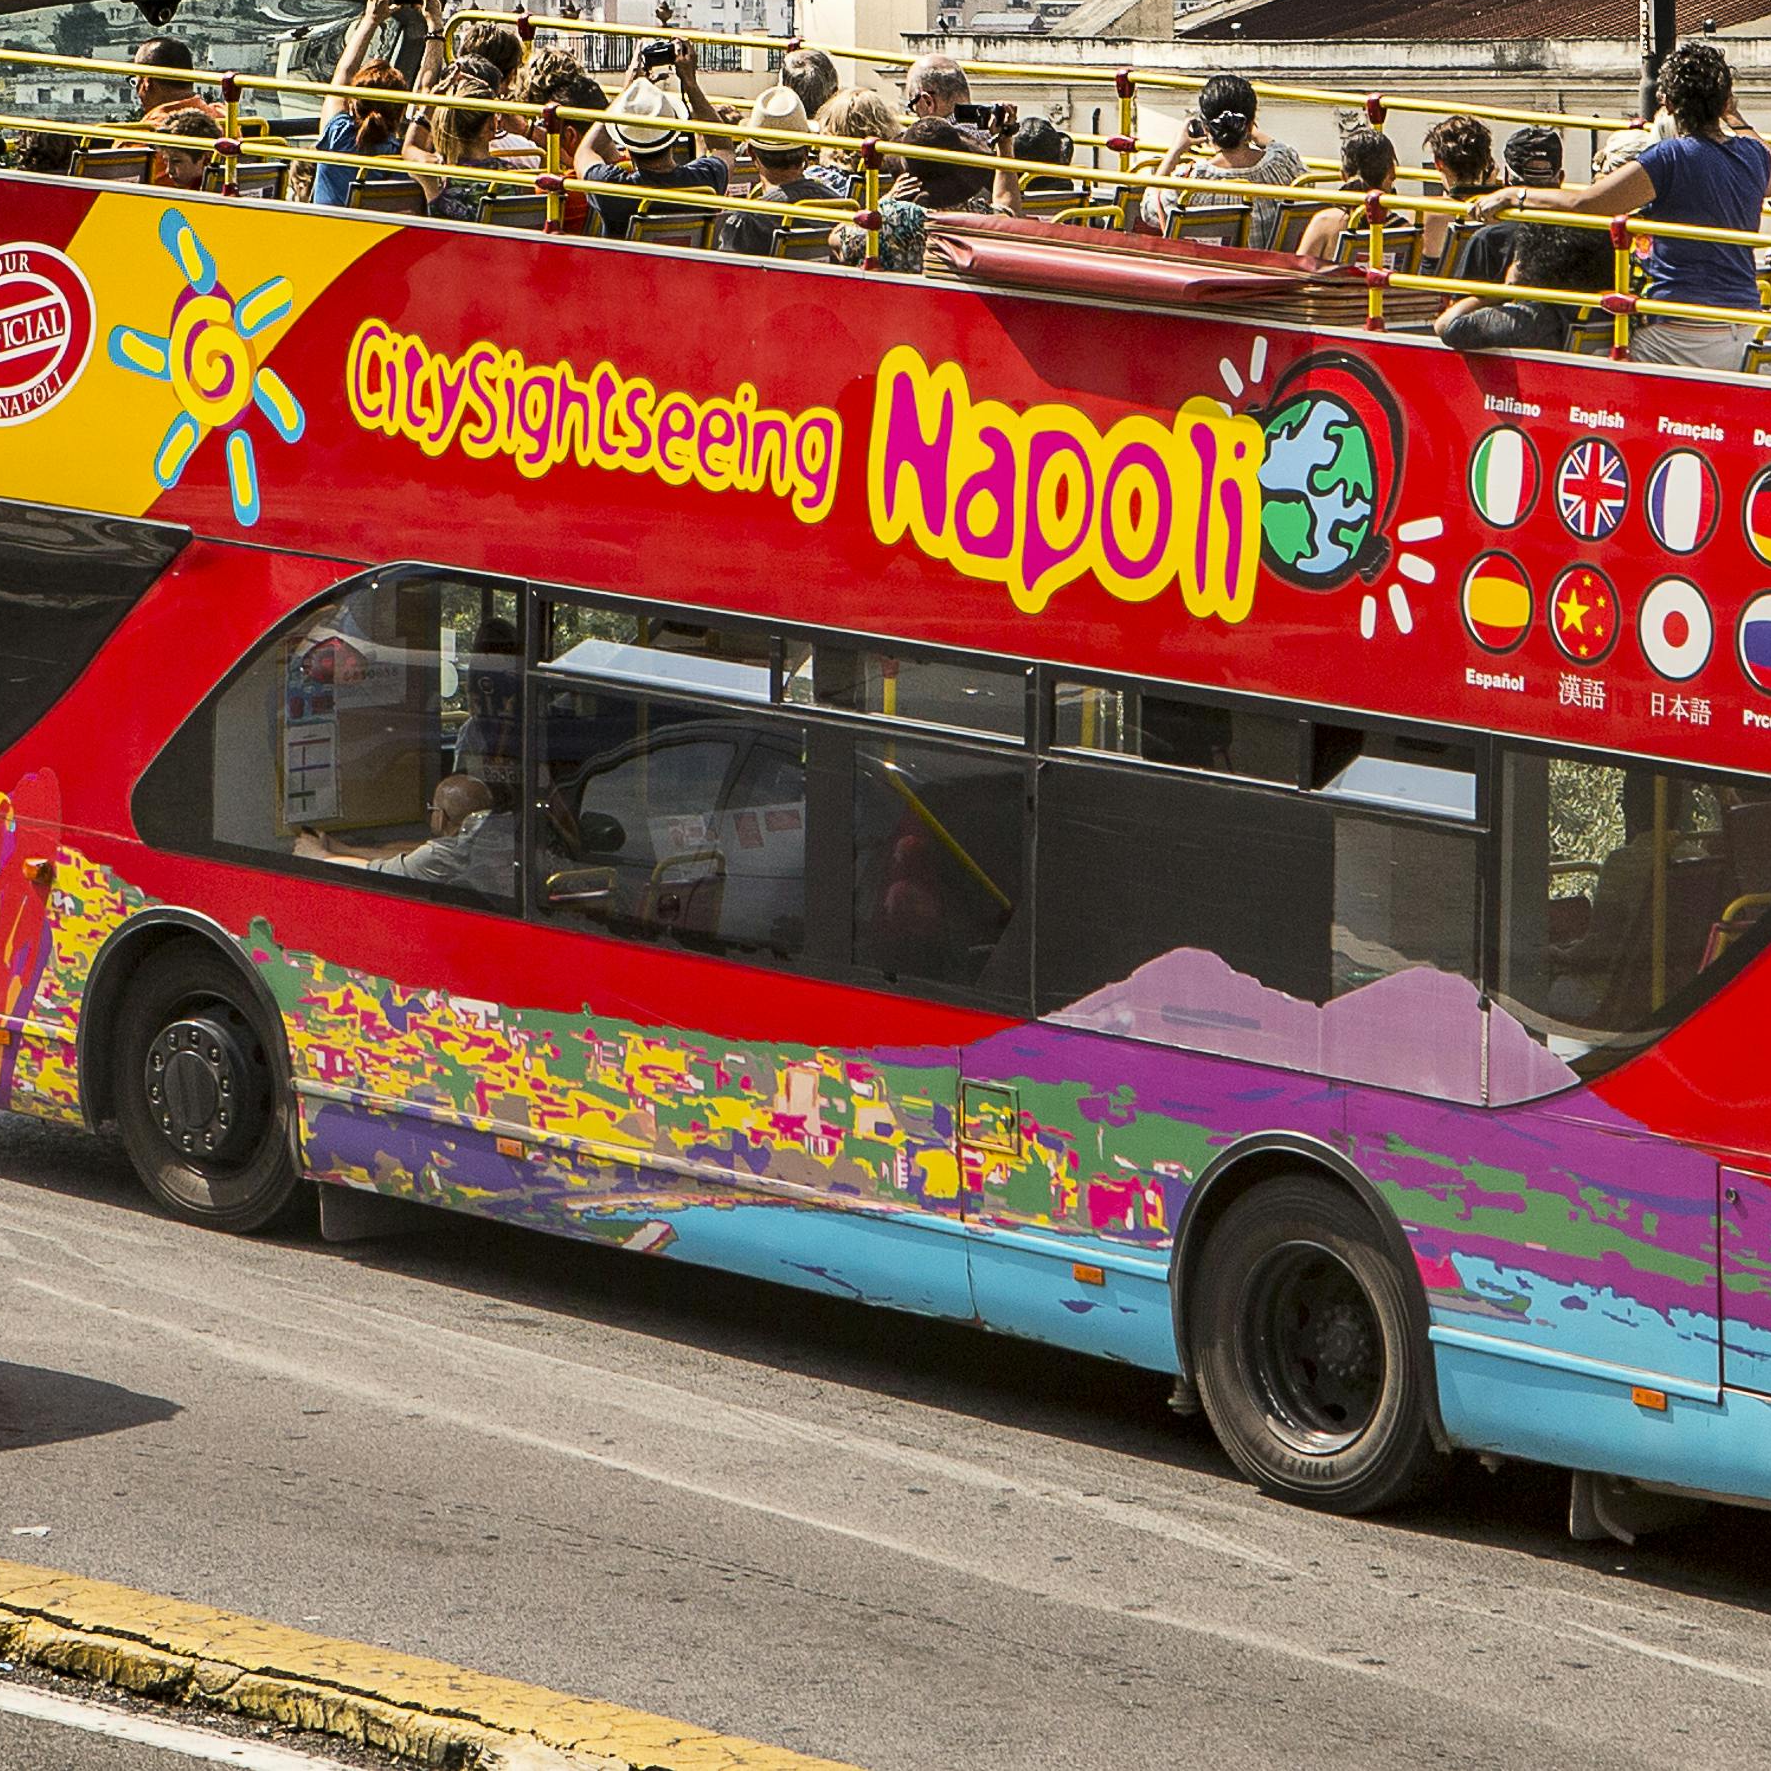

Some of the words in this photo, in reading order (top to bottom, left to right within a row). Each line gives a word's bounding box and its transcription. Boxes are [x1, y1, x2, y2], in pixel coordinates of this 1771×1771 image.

[1483, 394, 1541, 418] Italiano
[1568, 405, 1625, 430] English
[1657, 415, 1725, 442] Français
[869, 345, 1263, 622] Napoli
[1465, 667, 1525, 692] Español
[1557, 671, 1607, 710] 漢語
[1650, 691, 1712, 726] 日本語
